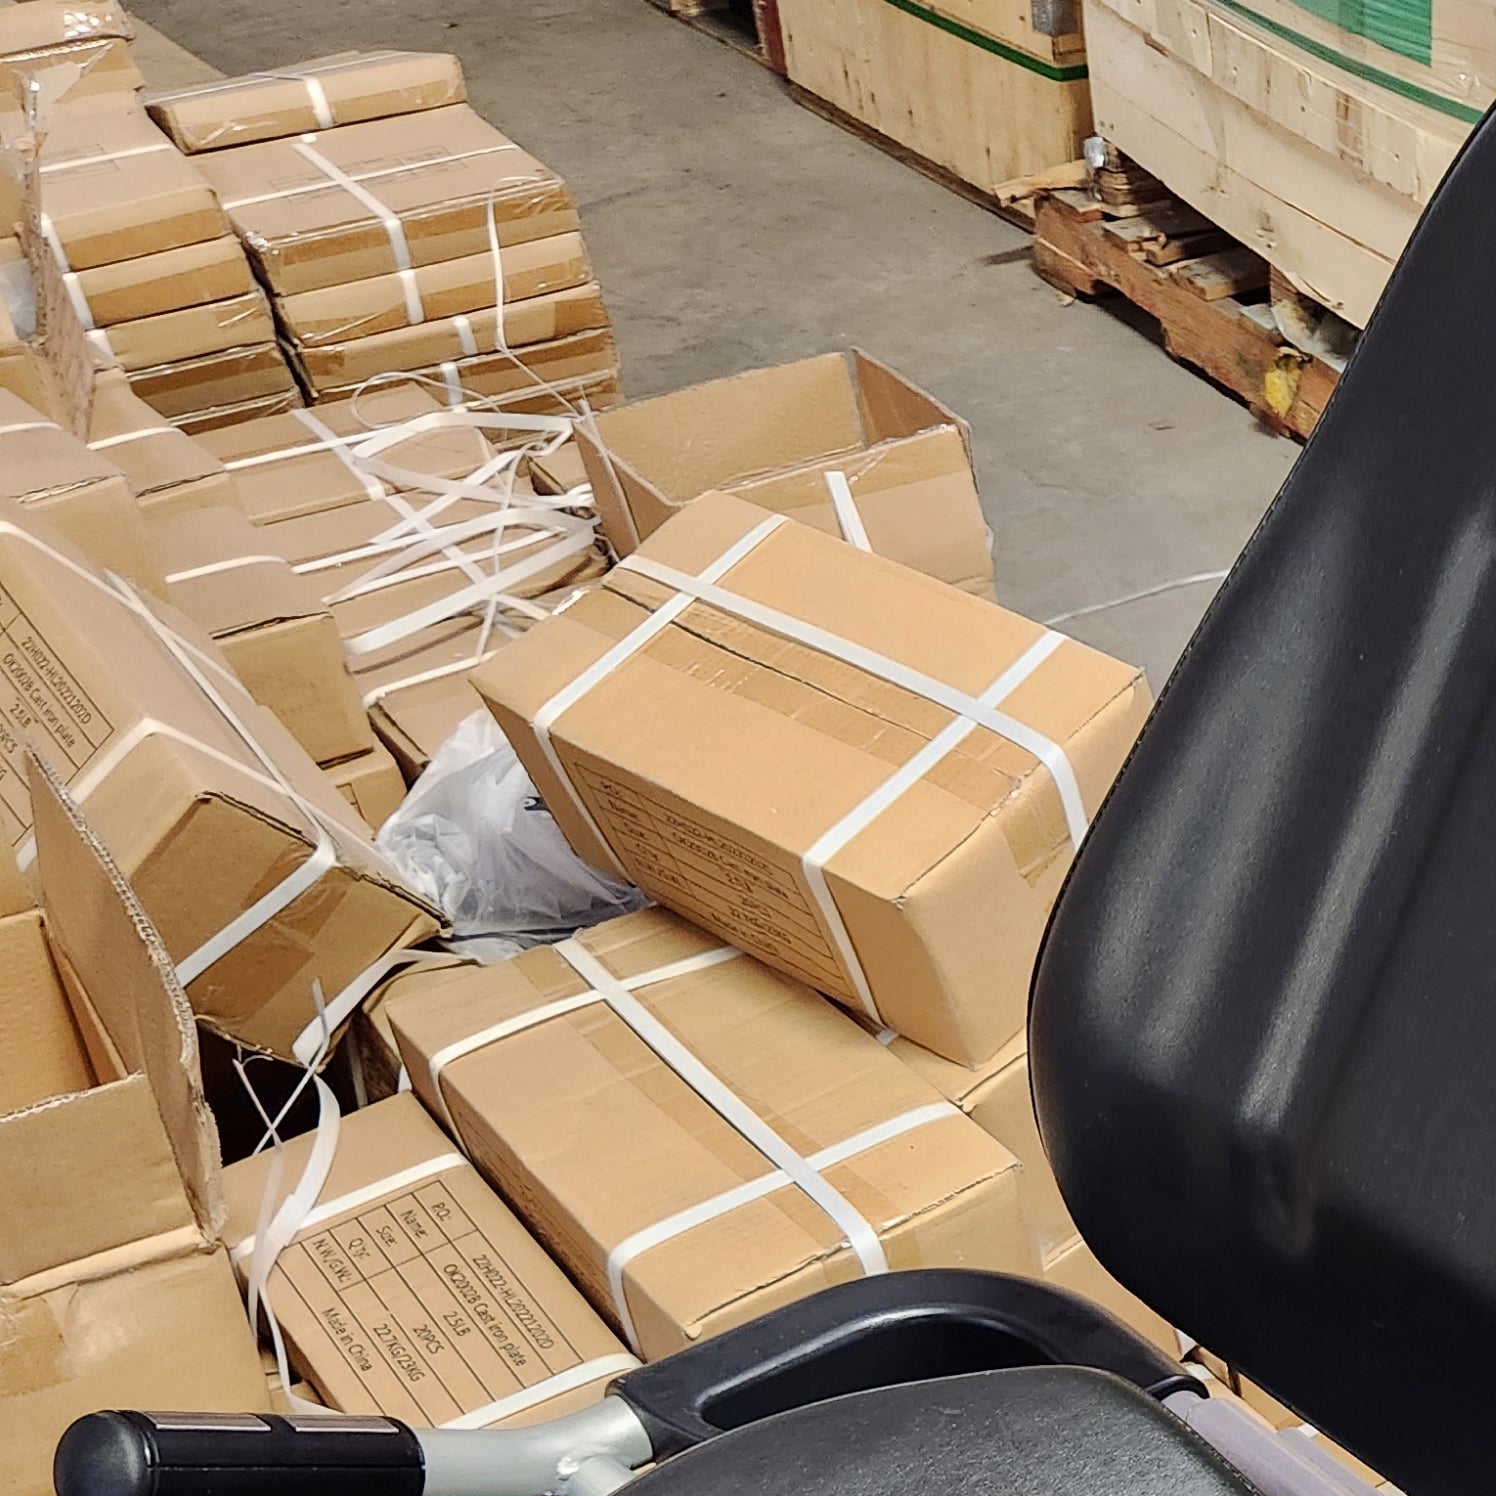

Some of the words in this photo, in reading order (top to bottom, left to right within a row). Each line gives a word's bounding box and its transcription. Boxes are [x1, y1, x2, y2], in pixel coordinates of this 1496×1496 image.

[400, 1210, 428, 1239] Name:
[473, 1303, 495, 1325] Cast
[488, 1322, 508, 1343] iron
[499, 1343, 526, 1366] plate
[322, 1307, 347, 1335] Made
[340, 1333, 354, 1345] in
[348, 1344, 372, 1371] China
[412, 1324, 445, 1354] 20PCS
